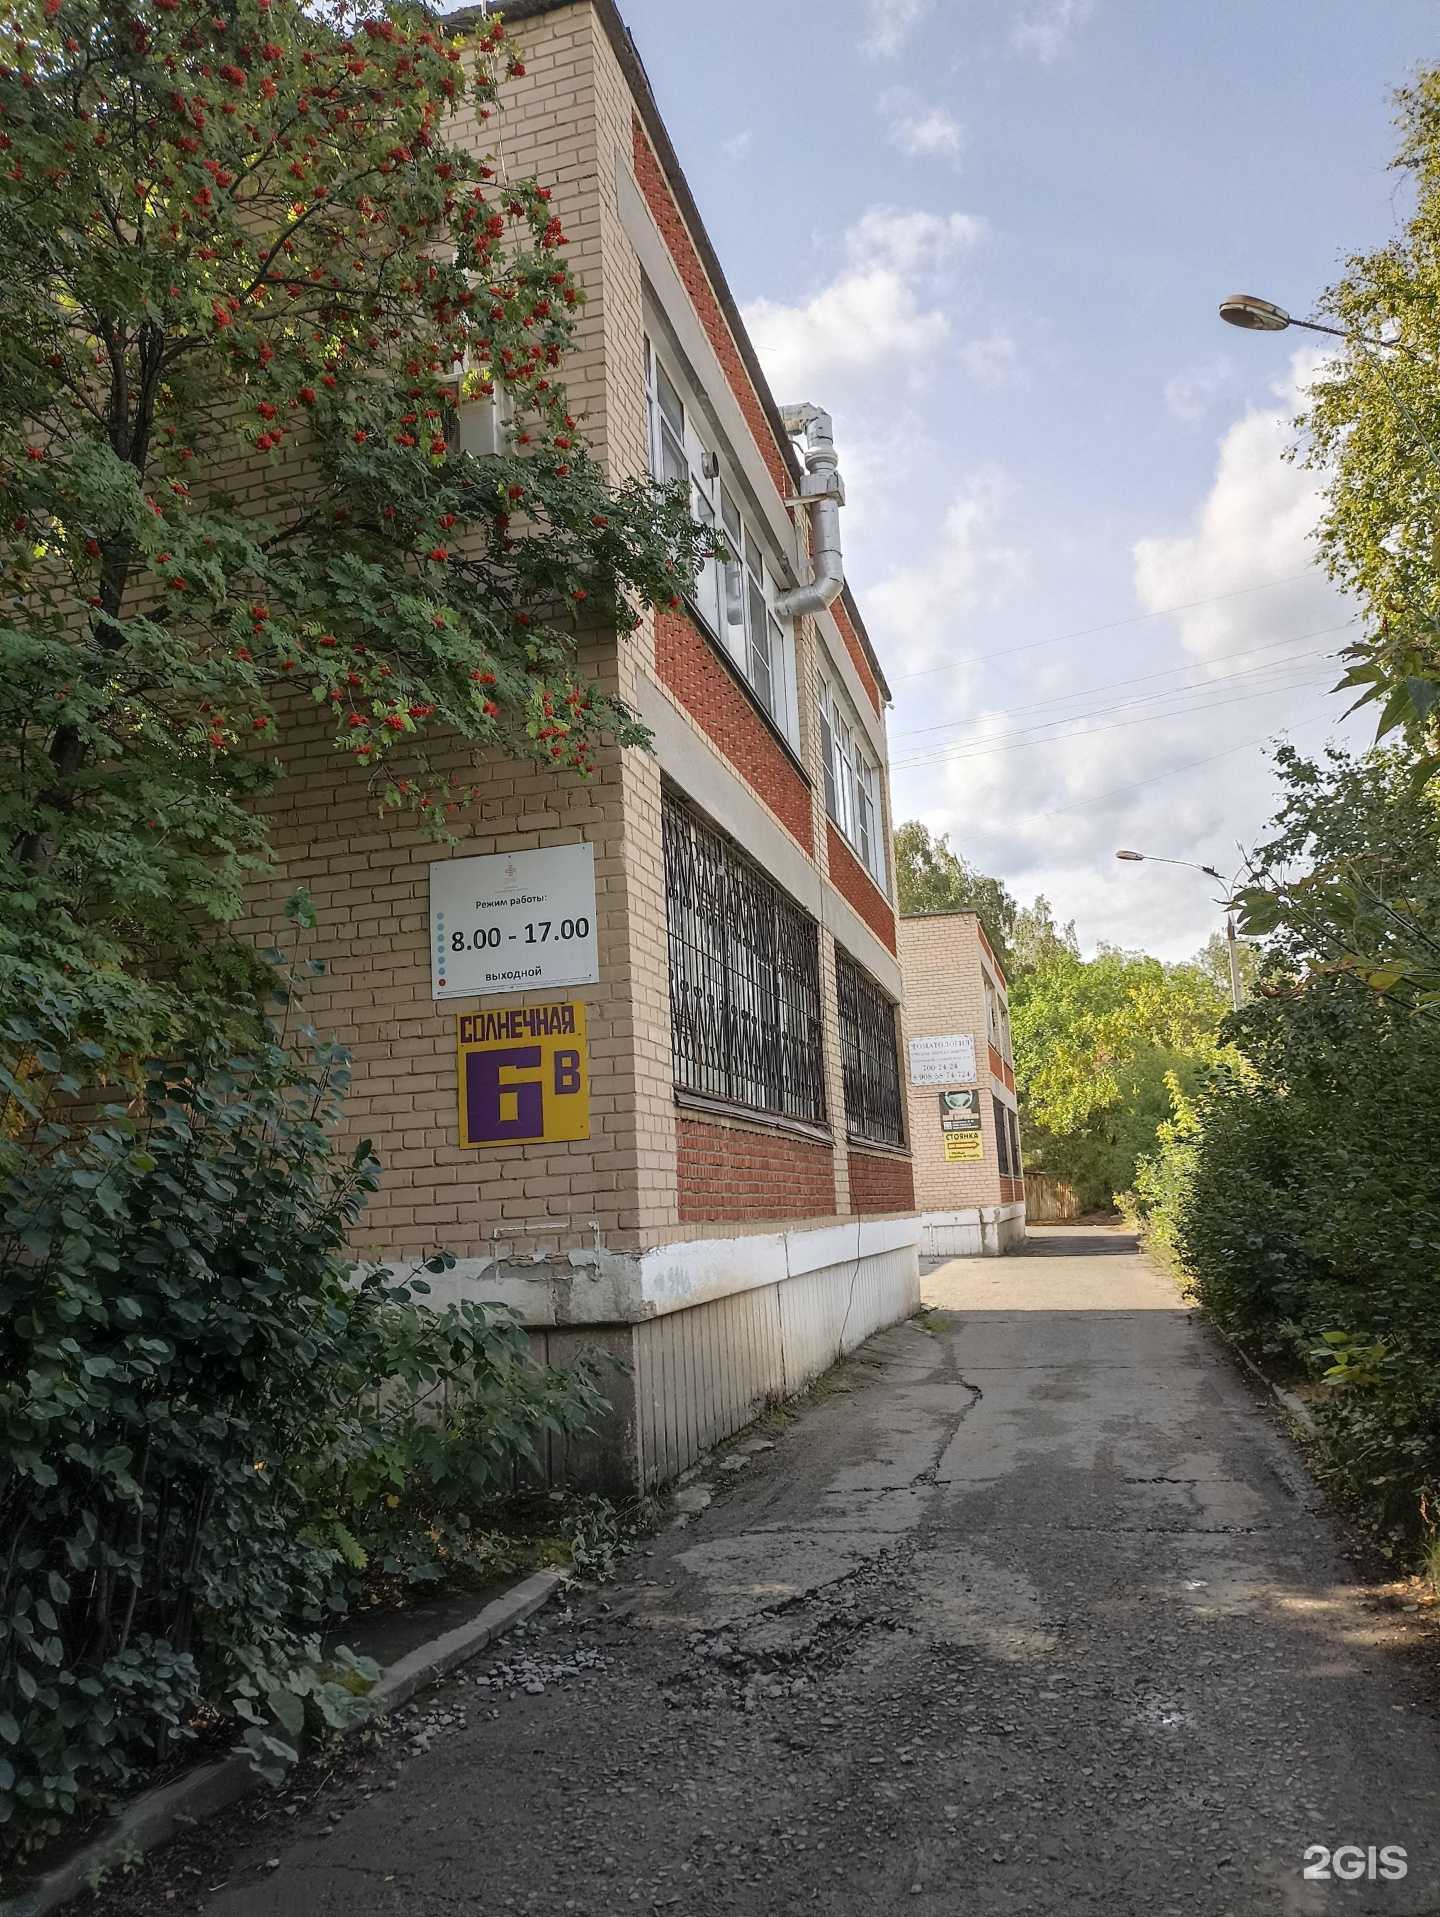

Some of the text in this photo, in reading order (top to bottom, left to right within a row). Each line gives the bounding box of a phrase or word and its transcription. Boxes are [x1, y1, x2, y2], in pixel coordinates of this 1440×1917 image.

[475, 894, 547, 909] Режим работы:
[451, 927, 501, 952] 8.00
[525, 917, 589, 944] 17.00
[460, 1006, 575, 1043] СОЛНЕЧНАЯ
[466, 1045, 544, 1143] 6
[946, 1132, 979, 1141] СТОЯНКА
